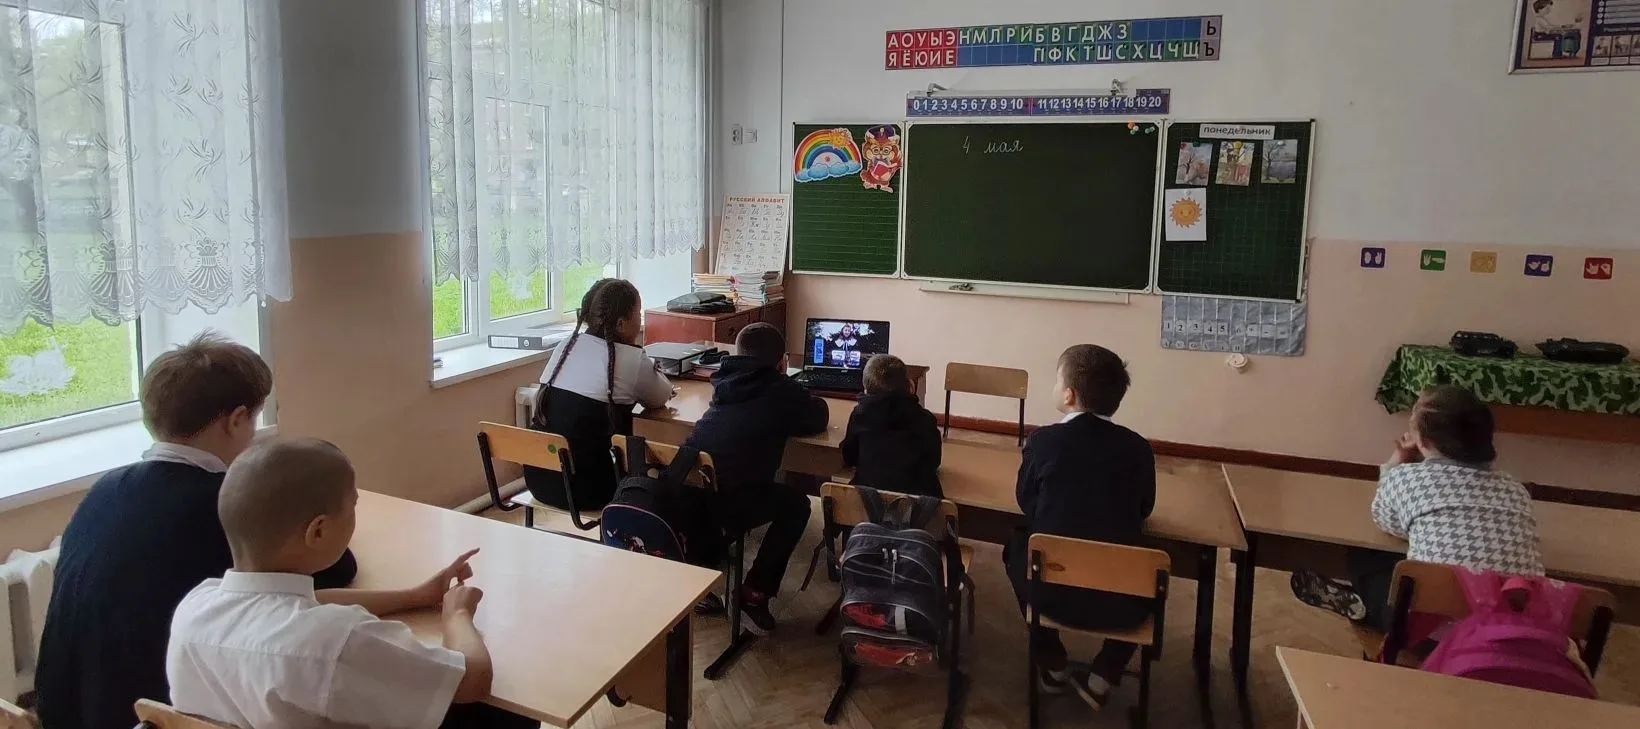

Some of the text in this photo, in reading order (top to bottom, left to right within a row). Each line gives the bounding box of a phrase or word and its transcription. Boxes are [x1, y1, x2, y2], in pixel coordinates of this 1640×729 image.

[914, 98, 1023, 110] 0 1 2 3 4 5 6 7 8 9 10
[1038, 96, 1161, 109] 11 12 13 14 15 16 17 18 19 20
[1203, 126, 1271, 136] понедельник
[962, 135, 1024, 154] 4 мая
